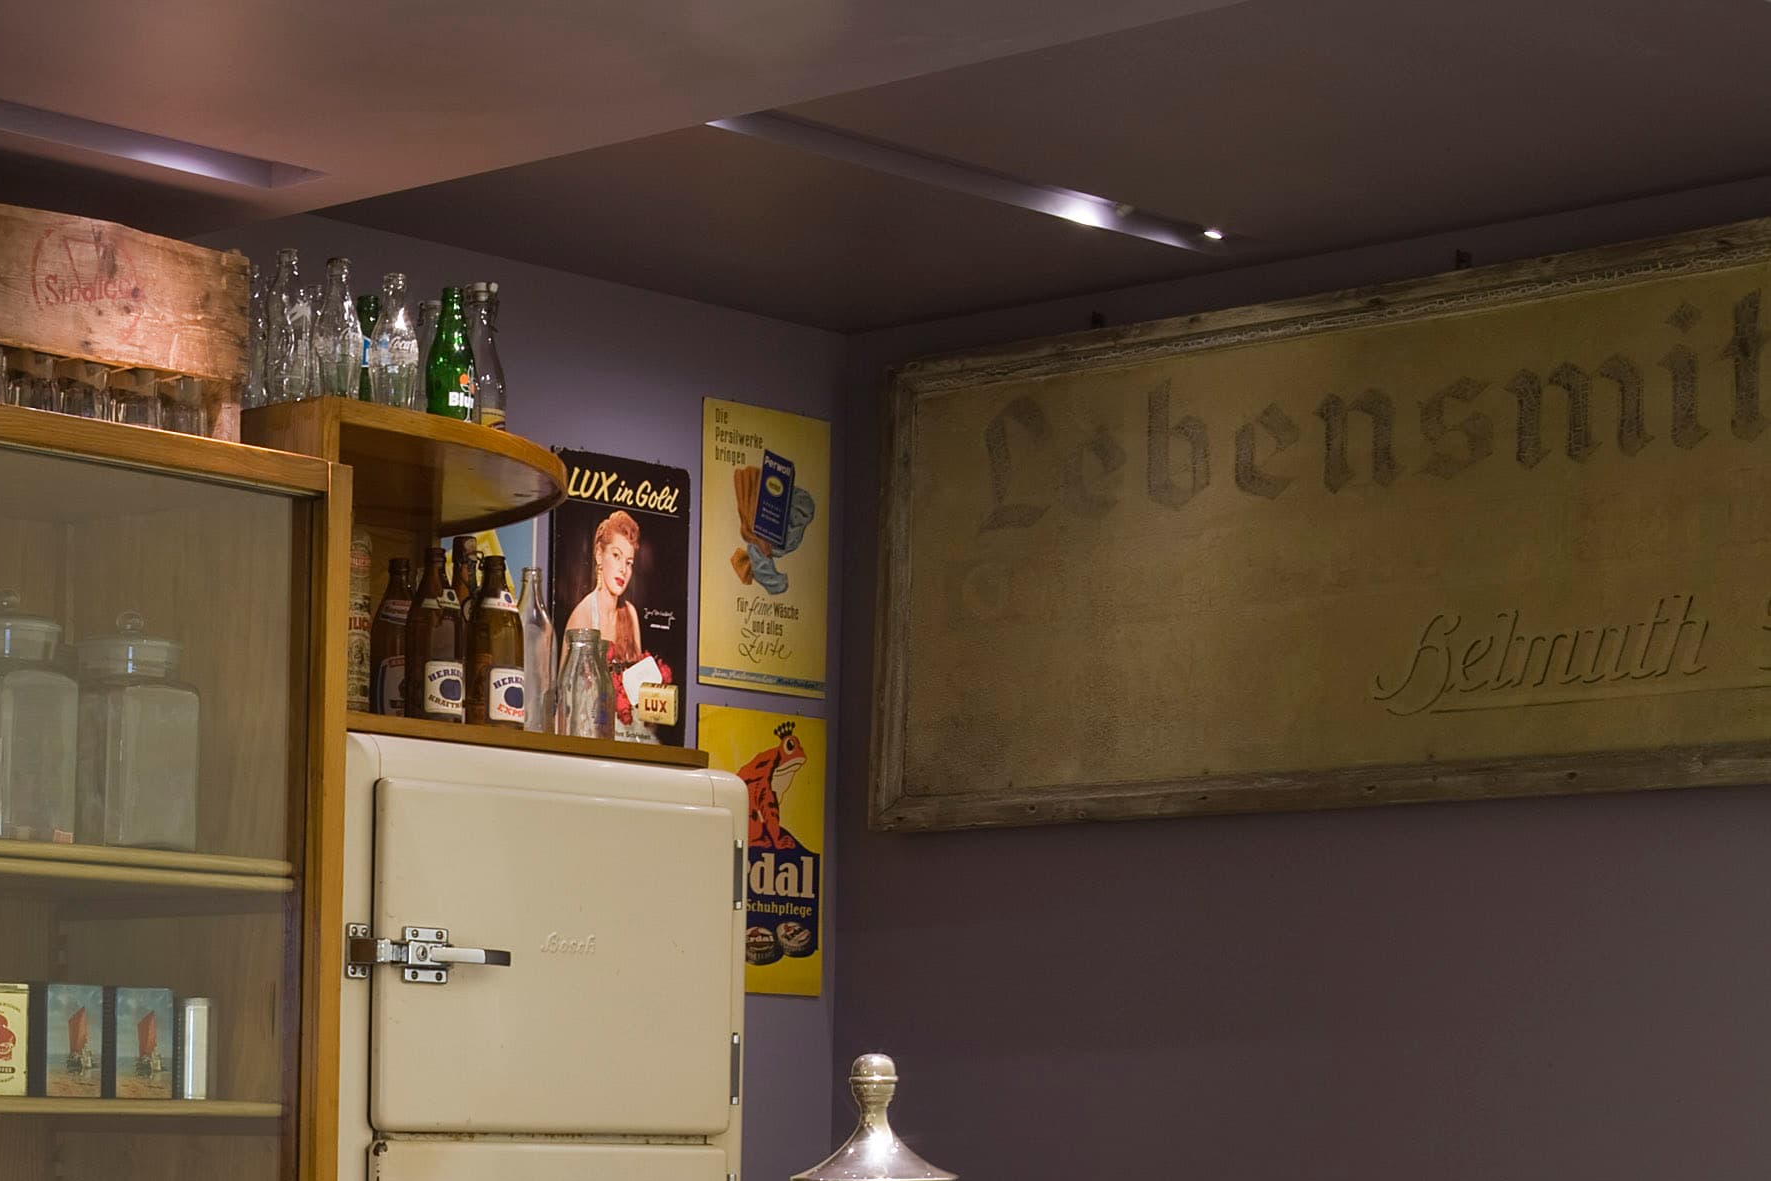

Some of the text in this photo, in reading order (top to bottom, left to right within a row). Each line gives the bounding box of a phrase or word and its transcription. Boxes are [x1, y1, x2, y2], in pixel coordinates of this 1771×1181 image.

[715, 407, 729, 424] Die
[715, 426, 765, 450] Persilwerke
[715, 445, 747, 466] bringen
[567, 466, 680, 514] LUX in Gold
[644, 698, 668, 714] LUX
[746, 898, 813, 917] Schuhpflege
[540, 930, 597, 956] Bosch
